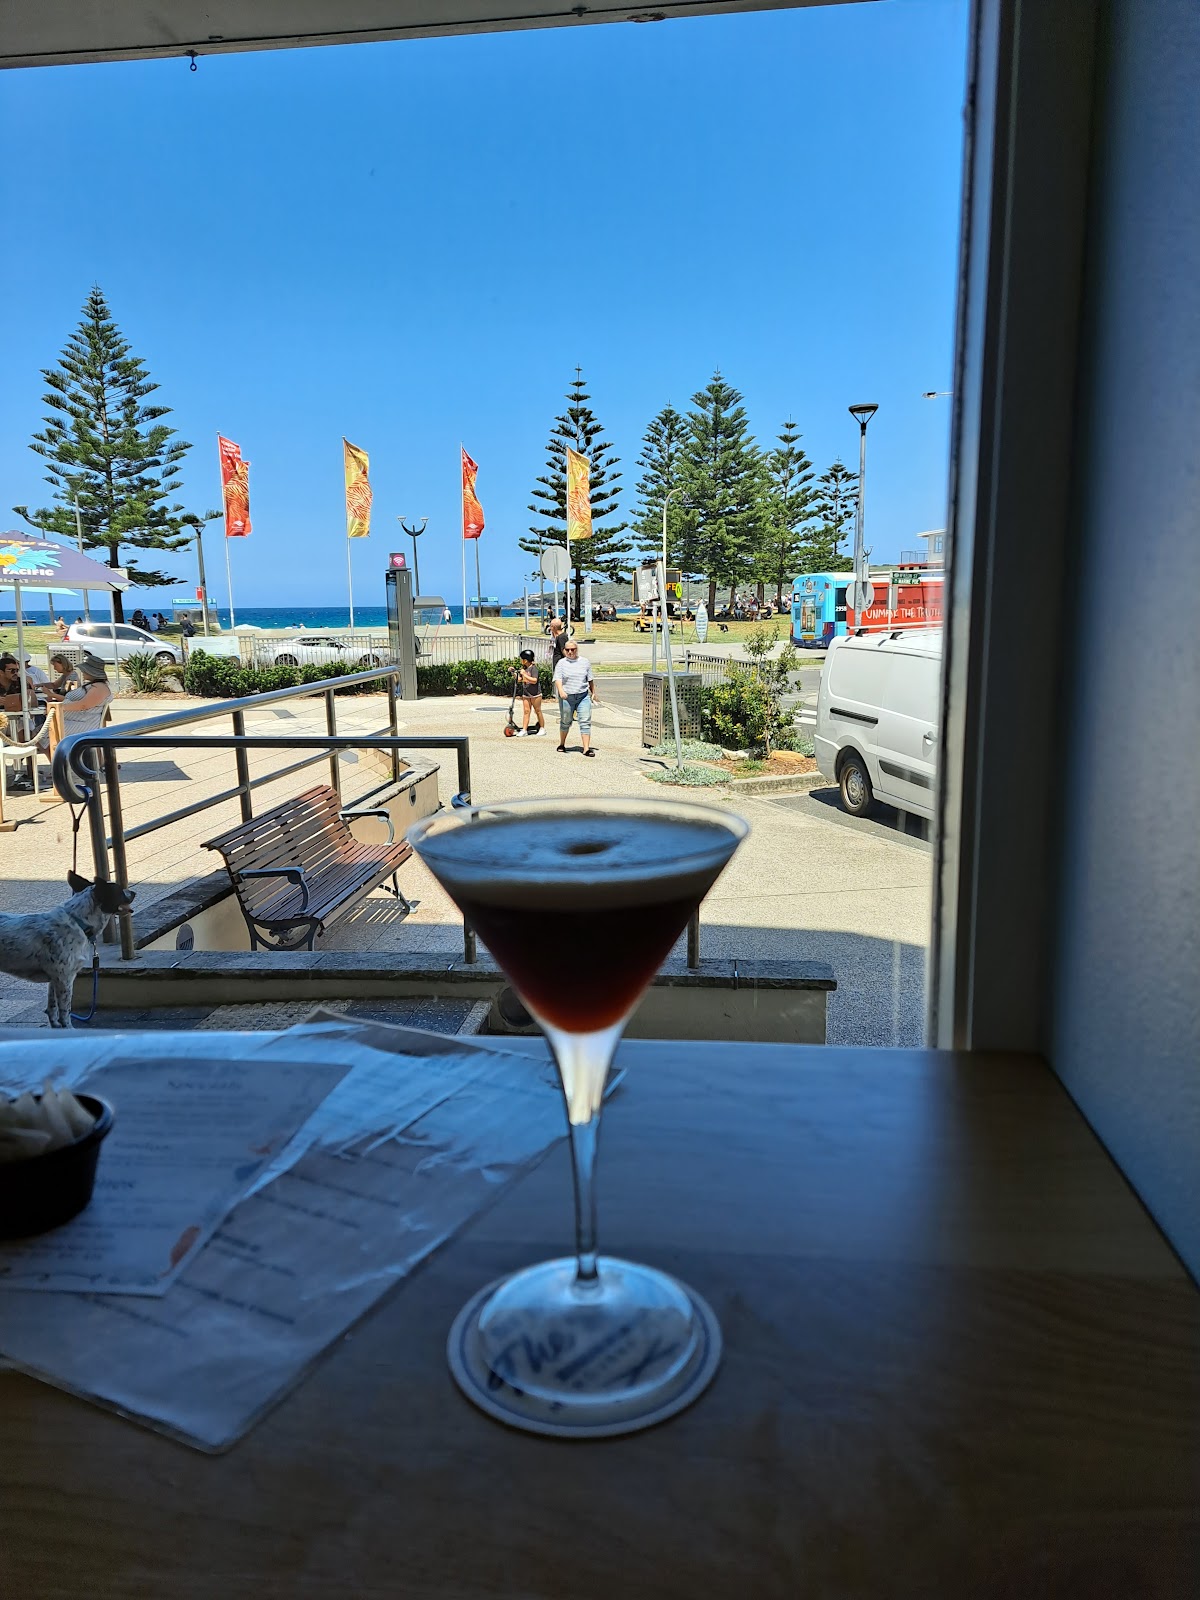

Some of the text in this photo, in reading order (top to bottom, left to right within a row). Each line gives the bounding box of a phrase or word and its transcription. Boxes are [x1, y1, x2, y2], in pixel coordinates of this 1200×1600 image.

[2, 568, 55, 577] PACIFIC
[901, 607, 916, 619] THE
[917, 606, 942, 618] TRUTH
